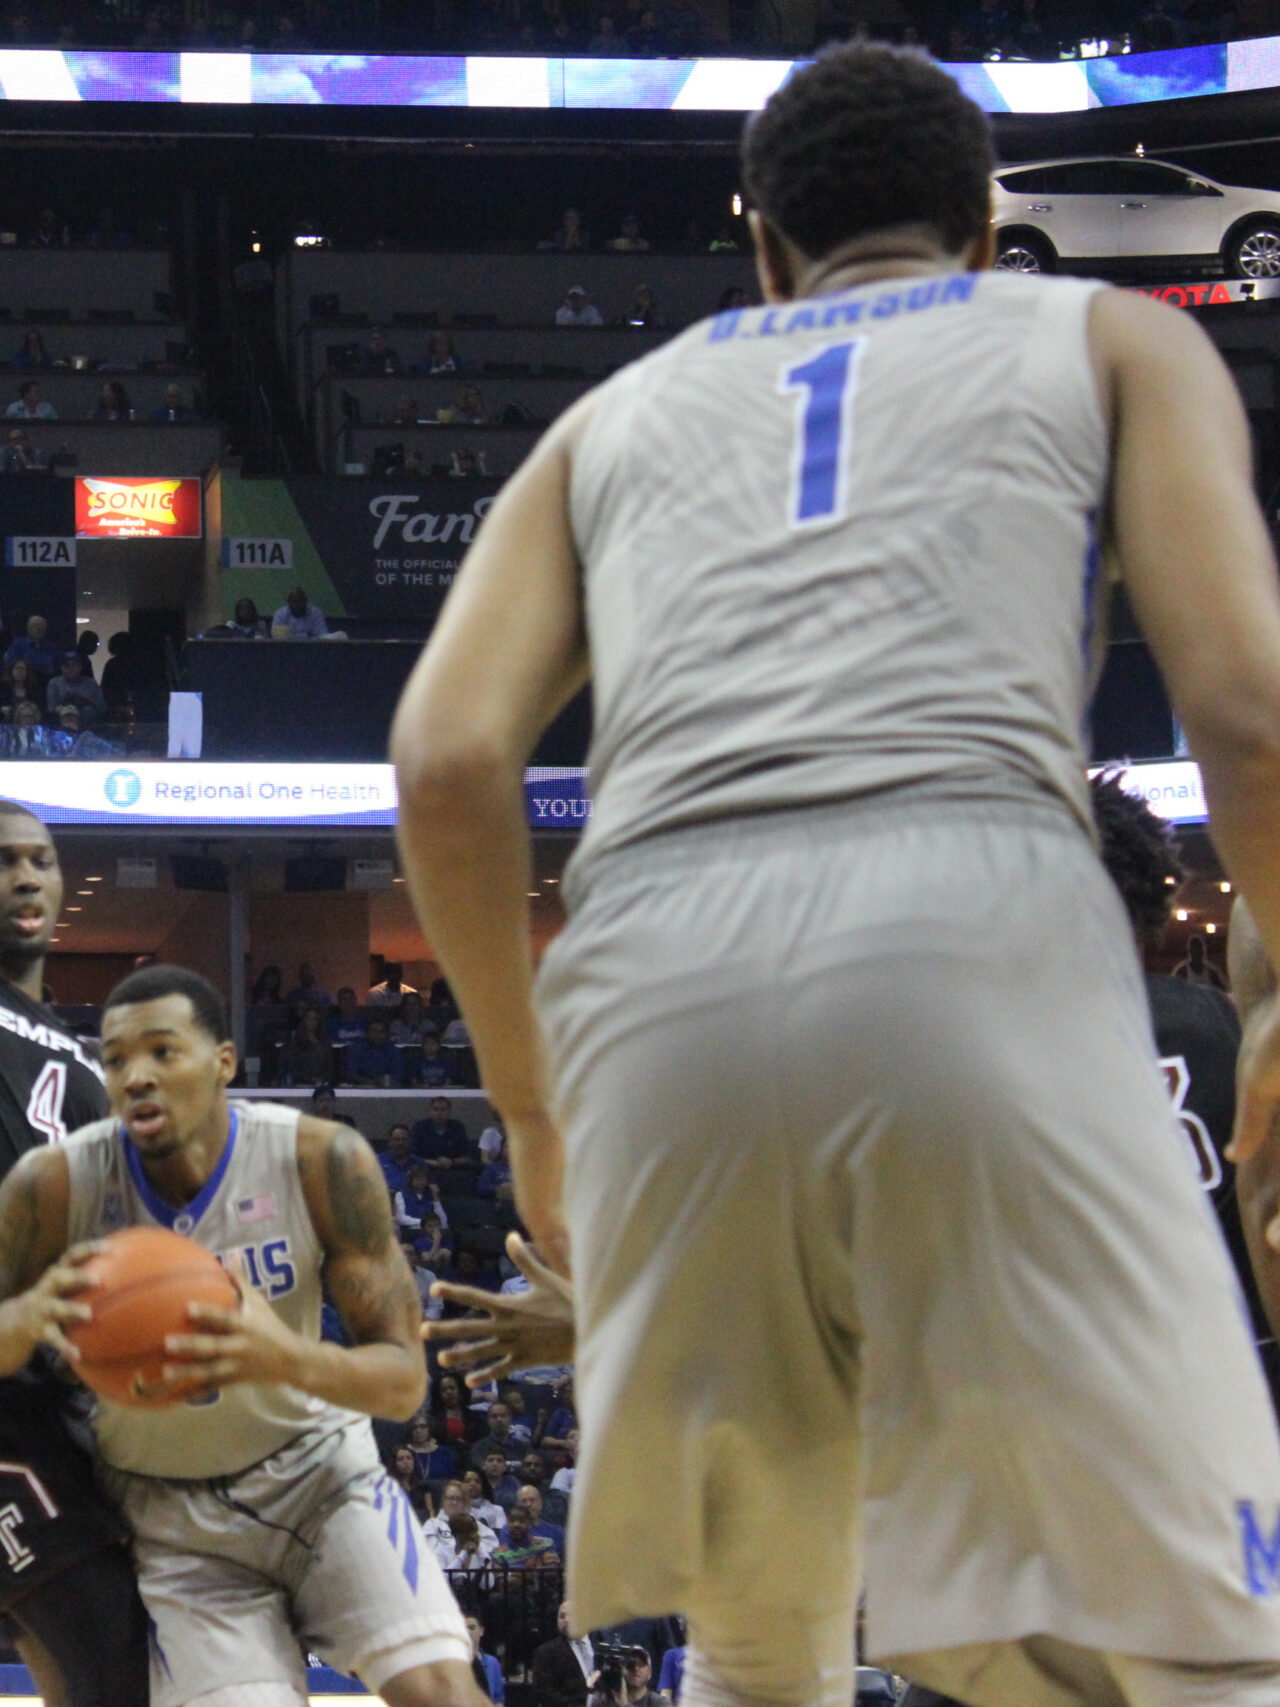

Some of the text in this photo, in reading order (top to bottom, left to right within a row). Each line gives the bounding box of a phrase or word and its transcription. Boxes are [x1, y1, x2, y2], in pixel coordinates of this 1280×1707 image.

[1126, 284, 1232, 308] OTA
[777, 336, 868, 529] 1
[94, 491, 175, 511] SONIC
[18, 541, 70, 563] 112A
[236, 542, 285, 565] 111A
[375, 559, 400, 569] THE
[375, 573, 397, 585] OF
[402, 573, 433, 586] THE
[154, 781, 380, 802] Regional One Health
[26, 1060, 67, 1147] 4
